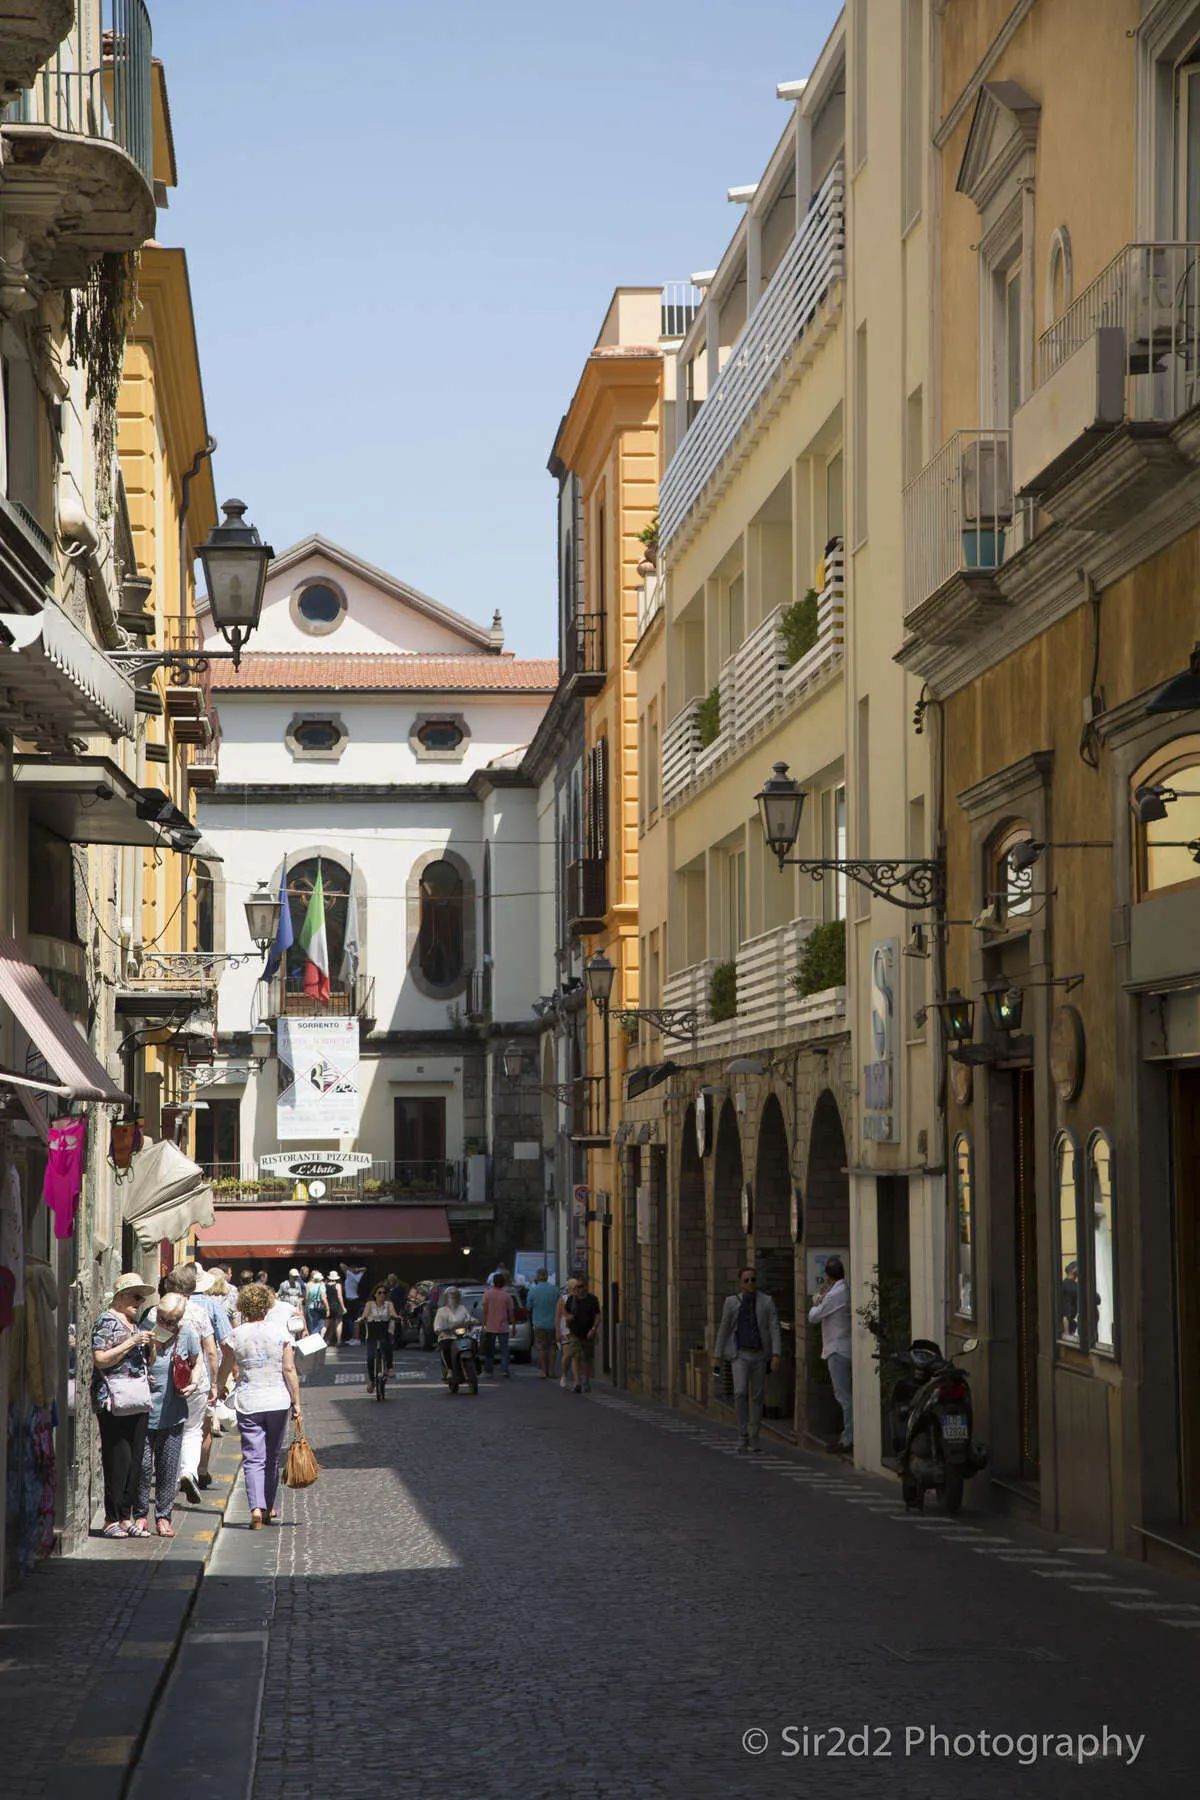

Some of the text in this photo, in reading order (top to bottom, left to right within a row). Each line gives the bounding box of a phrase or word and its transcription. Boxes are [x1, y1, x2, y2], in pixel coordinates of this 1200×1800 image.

[262, 1152, 370, 1165] RISTORANTE PIZZERIA
[296, 1164, 336, 1175] L'Abate
